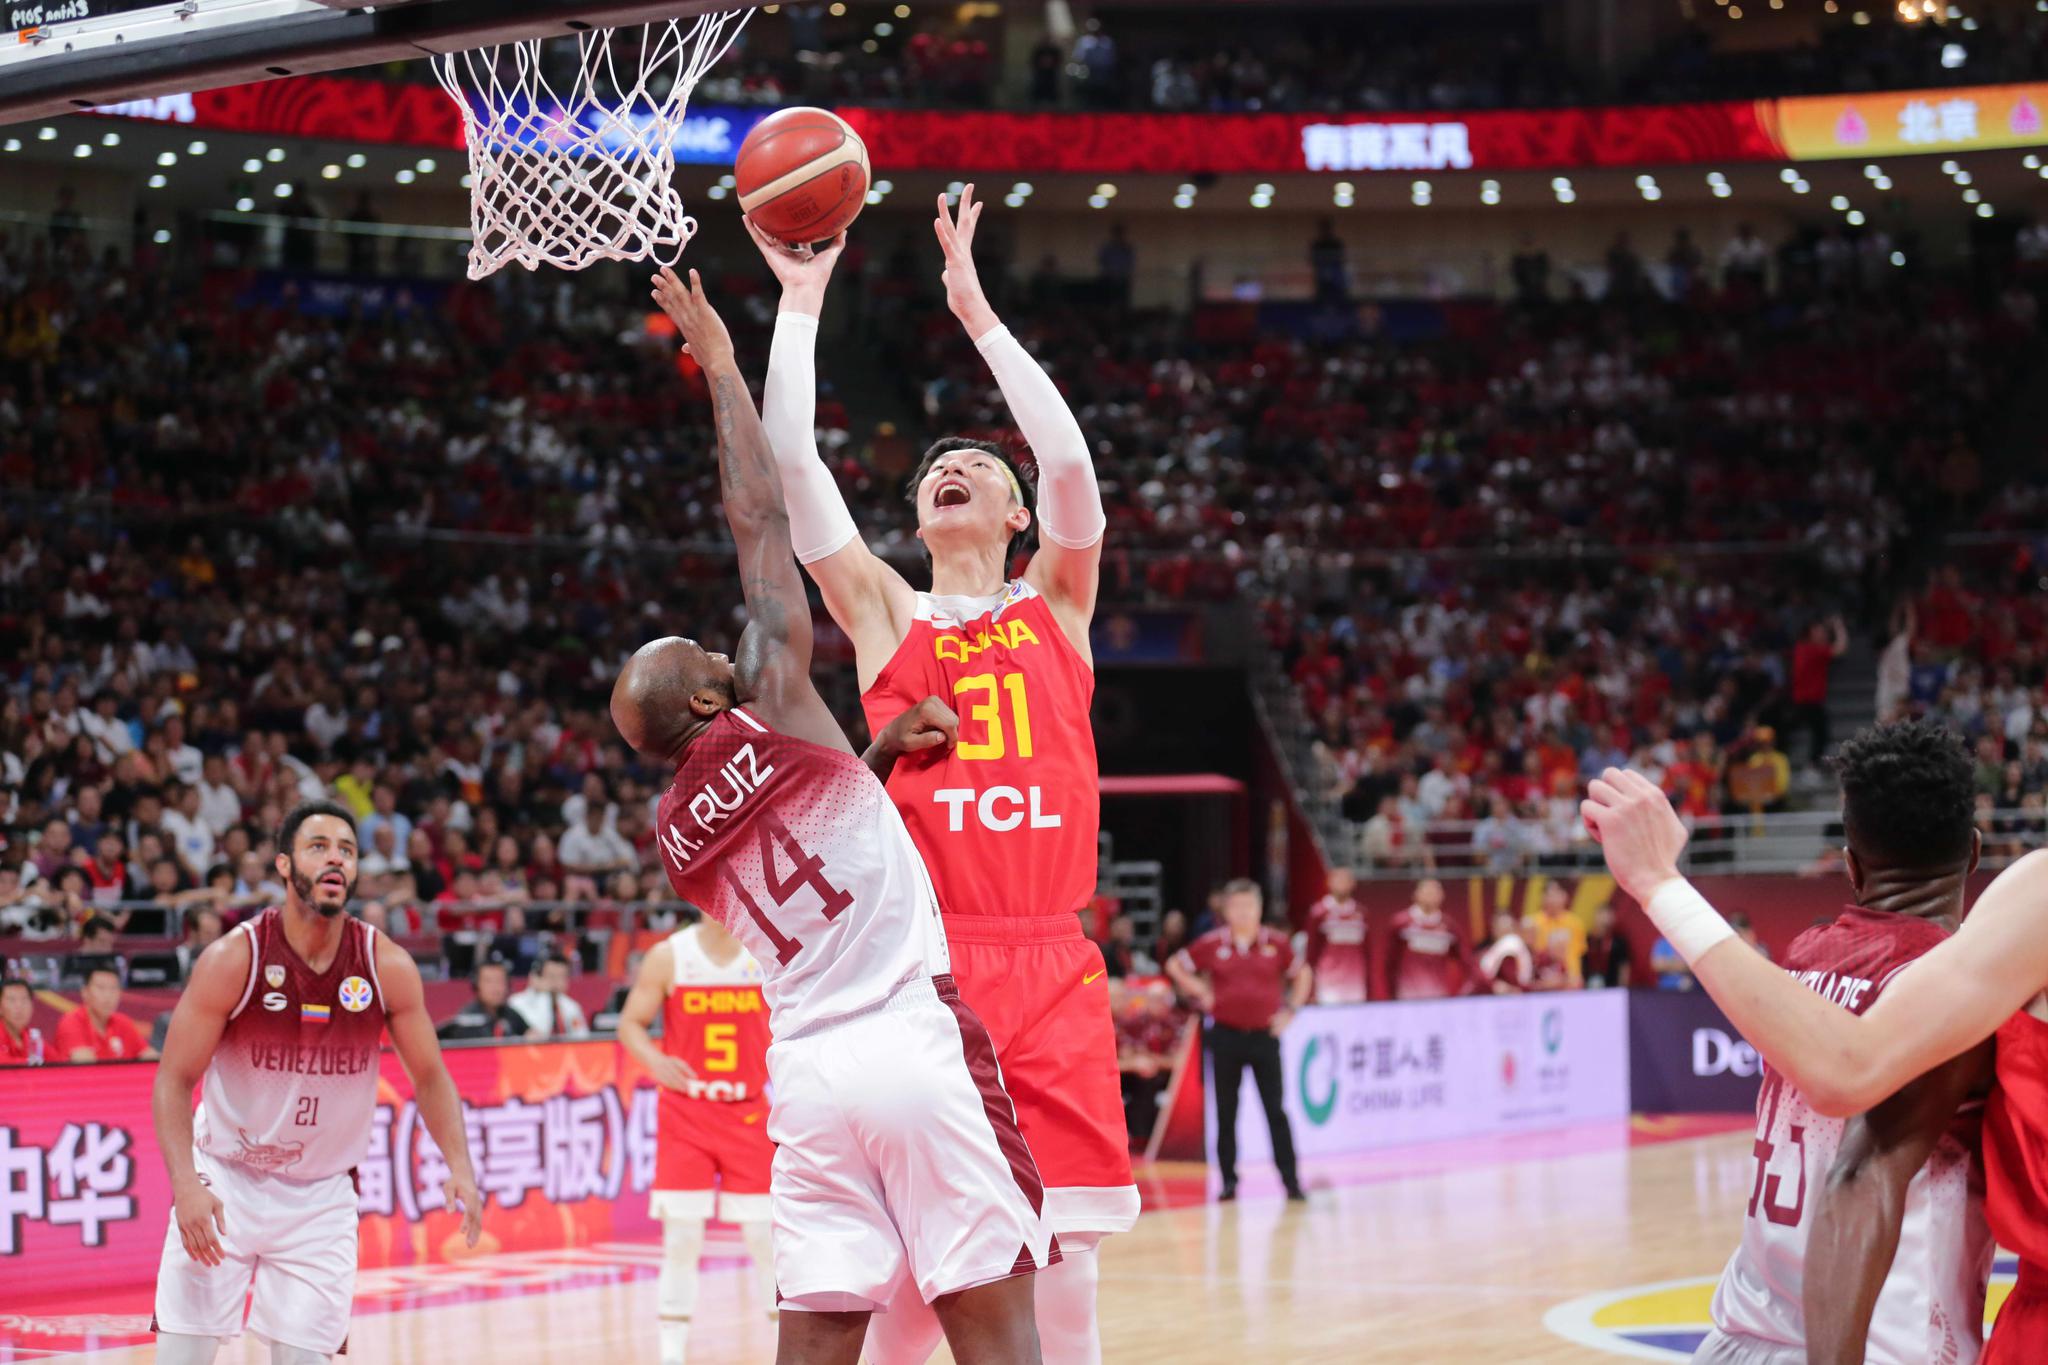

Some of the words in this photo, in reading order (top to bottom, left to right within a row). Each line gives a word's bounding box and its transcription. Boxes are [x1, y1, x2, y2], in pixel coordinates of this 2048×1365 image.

[935, 618, 1040, 663] CHINA
[953, 672, 1033, 760] 31
[661, 823, 704, 871] M.
[688, 743, 774, 834] RUIZ
[933, 785, 1062, 832] TCL
[716, 806, 855, 967] 14
[683, 991, 761, 1014] CHINA
[252, 1041, 369, 1076] VENEZUELA
[704, 1023, 737, 1072] 5
[1692, 1027, 1763, 1077] De
[295, 1096, 320, 1126] 21
